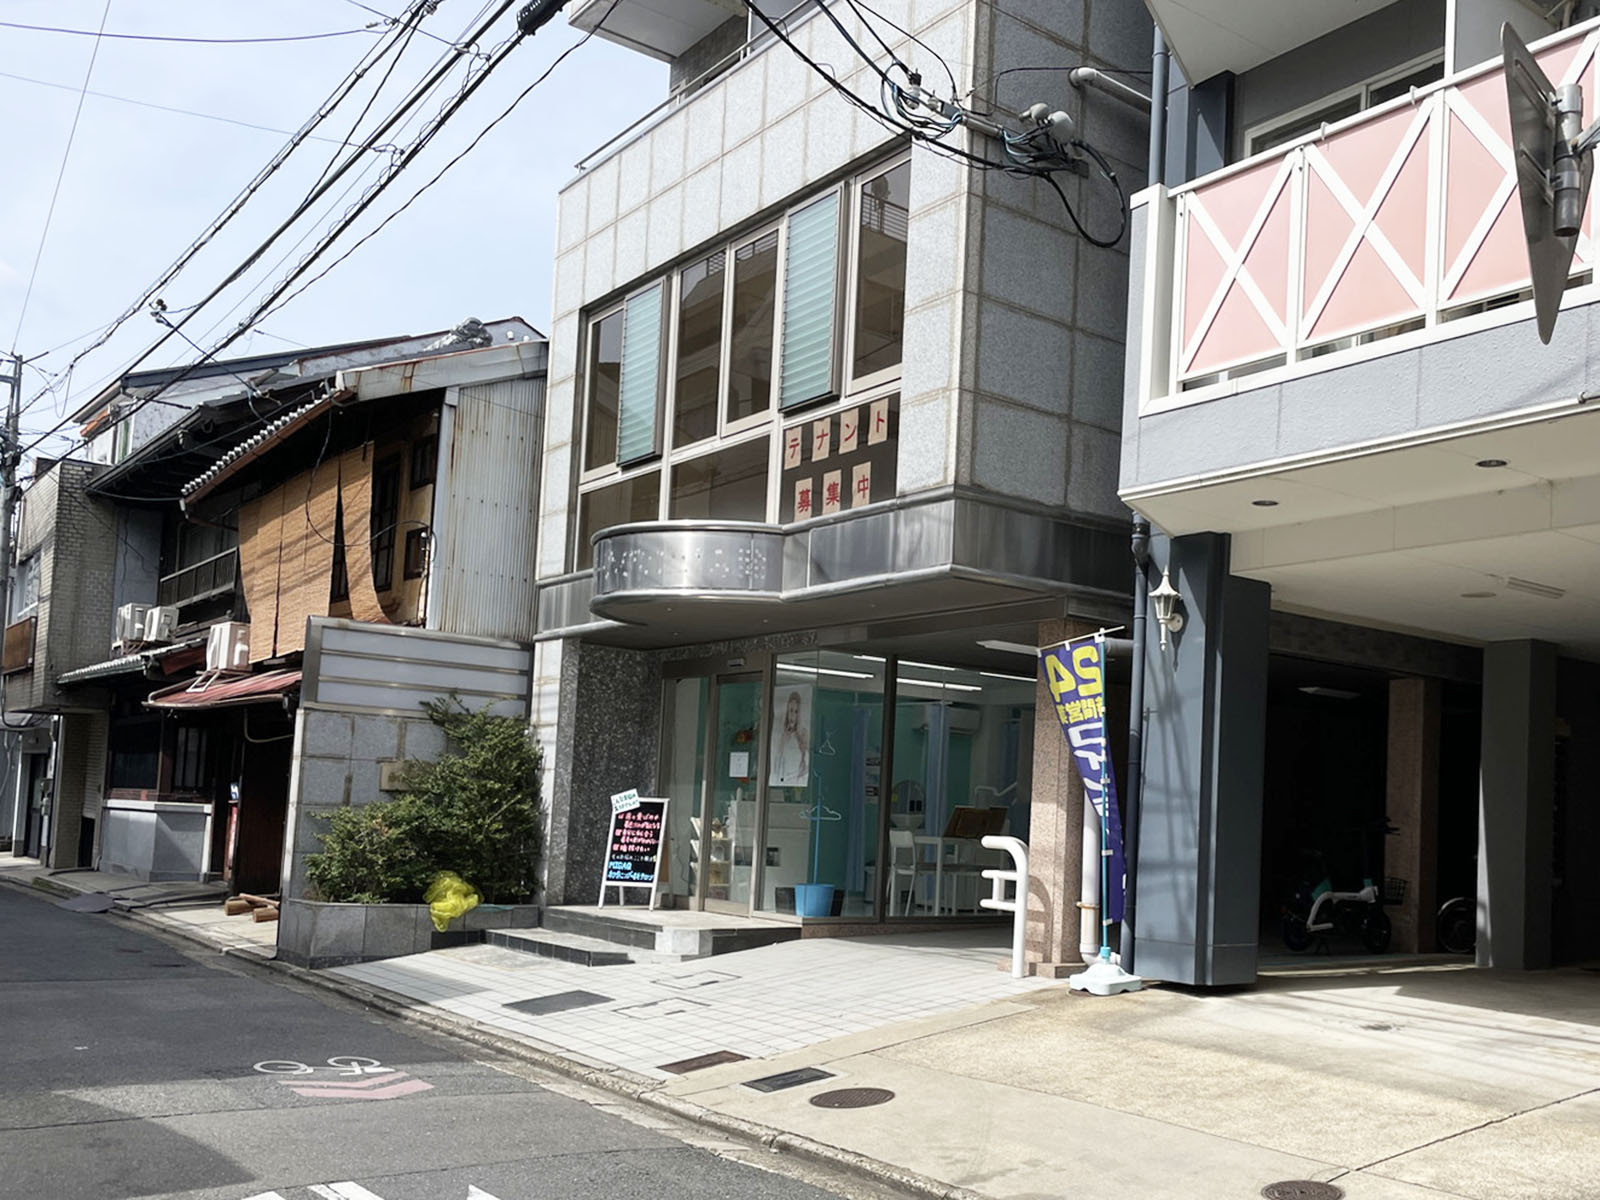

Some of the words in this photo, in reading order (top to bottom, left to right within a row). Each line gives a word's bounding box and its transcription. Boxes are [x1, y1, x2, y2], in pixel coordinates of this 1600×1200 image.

[788, 410, 885, 459] テナント
[797, 475, 869, 513] 募集中
